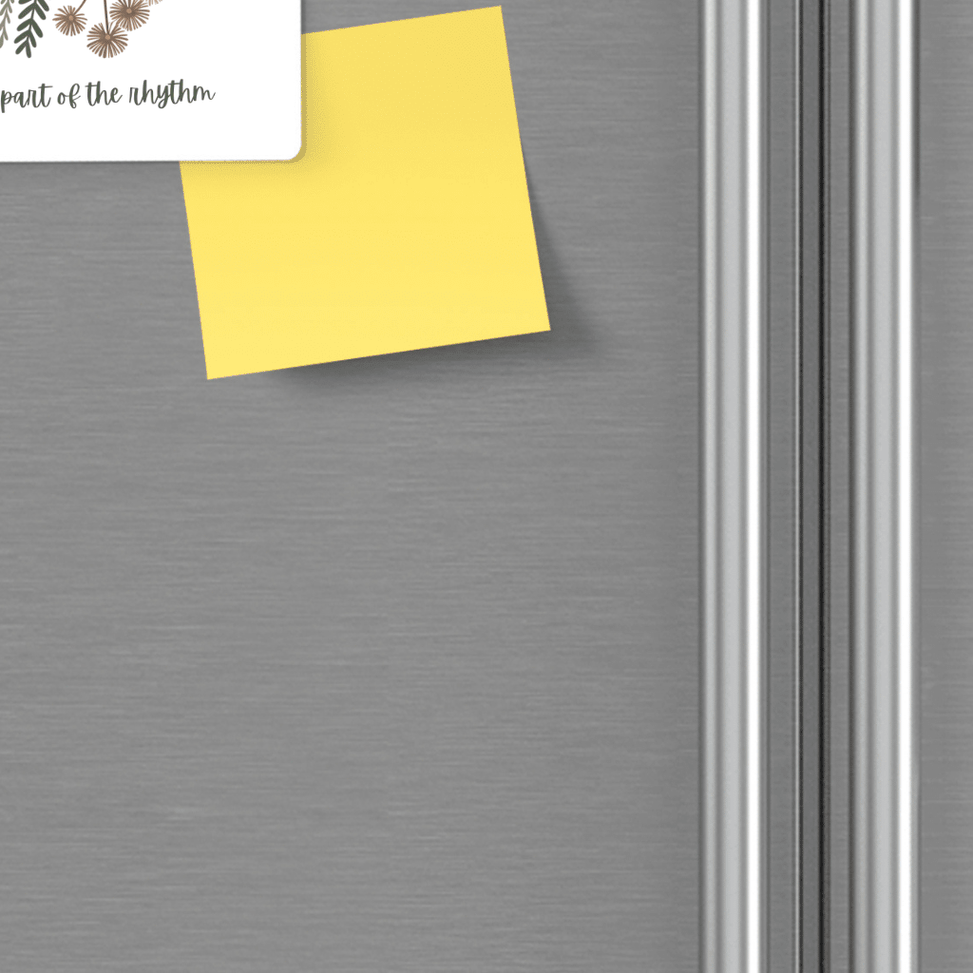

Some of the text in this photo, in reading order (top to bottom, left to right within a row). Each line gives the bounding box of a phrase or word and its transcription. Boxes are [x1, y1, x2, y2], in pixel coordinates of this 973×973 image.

[0, 83, 53, 113] part
[57, 83, 81, 109] of
[85, 81, 123, 107] the
[129, 78, 216, 109] rhythm
